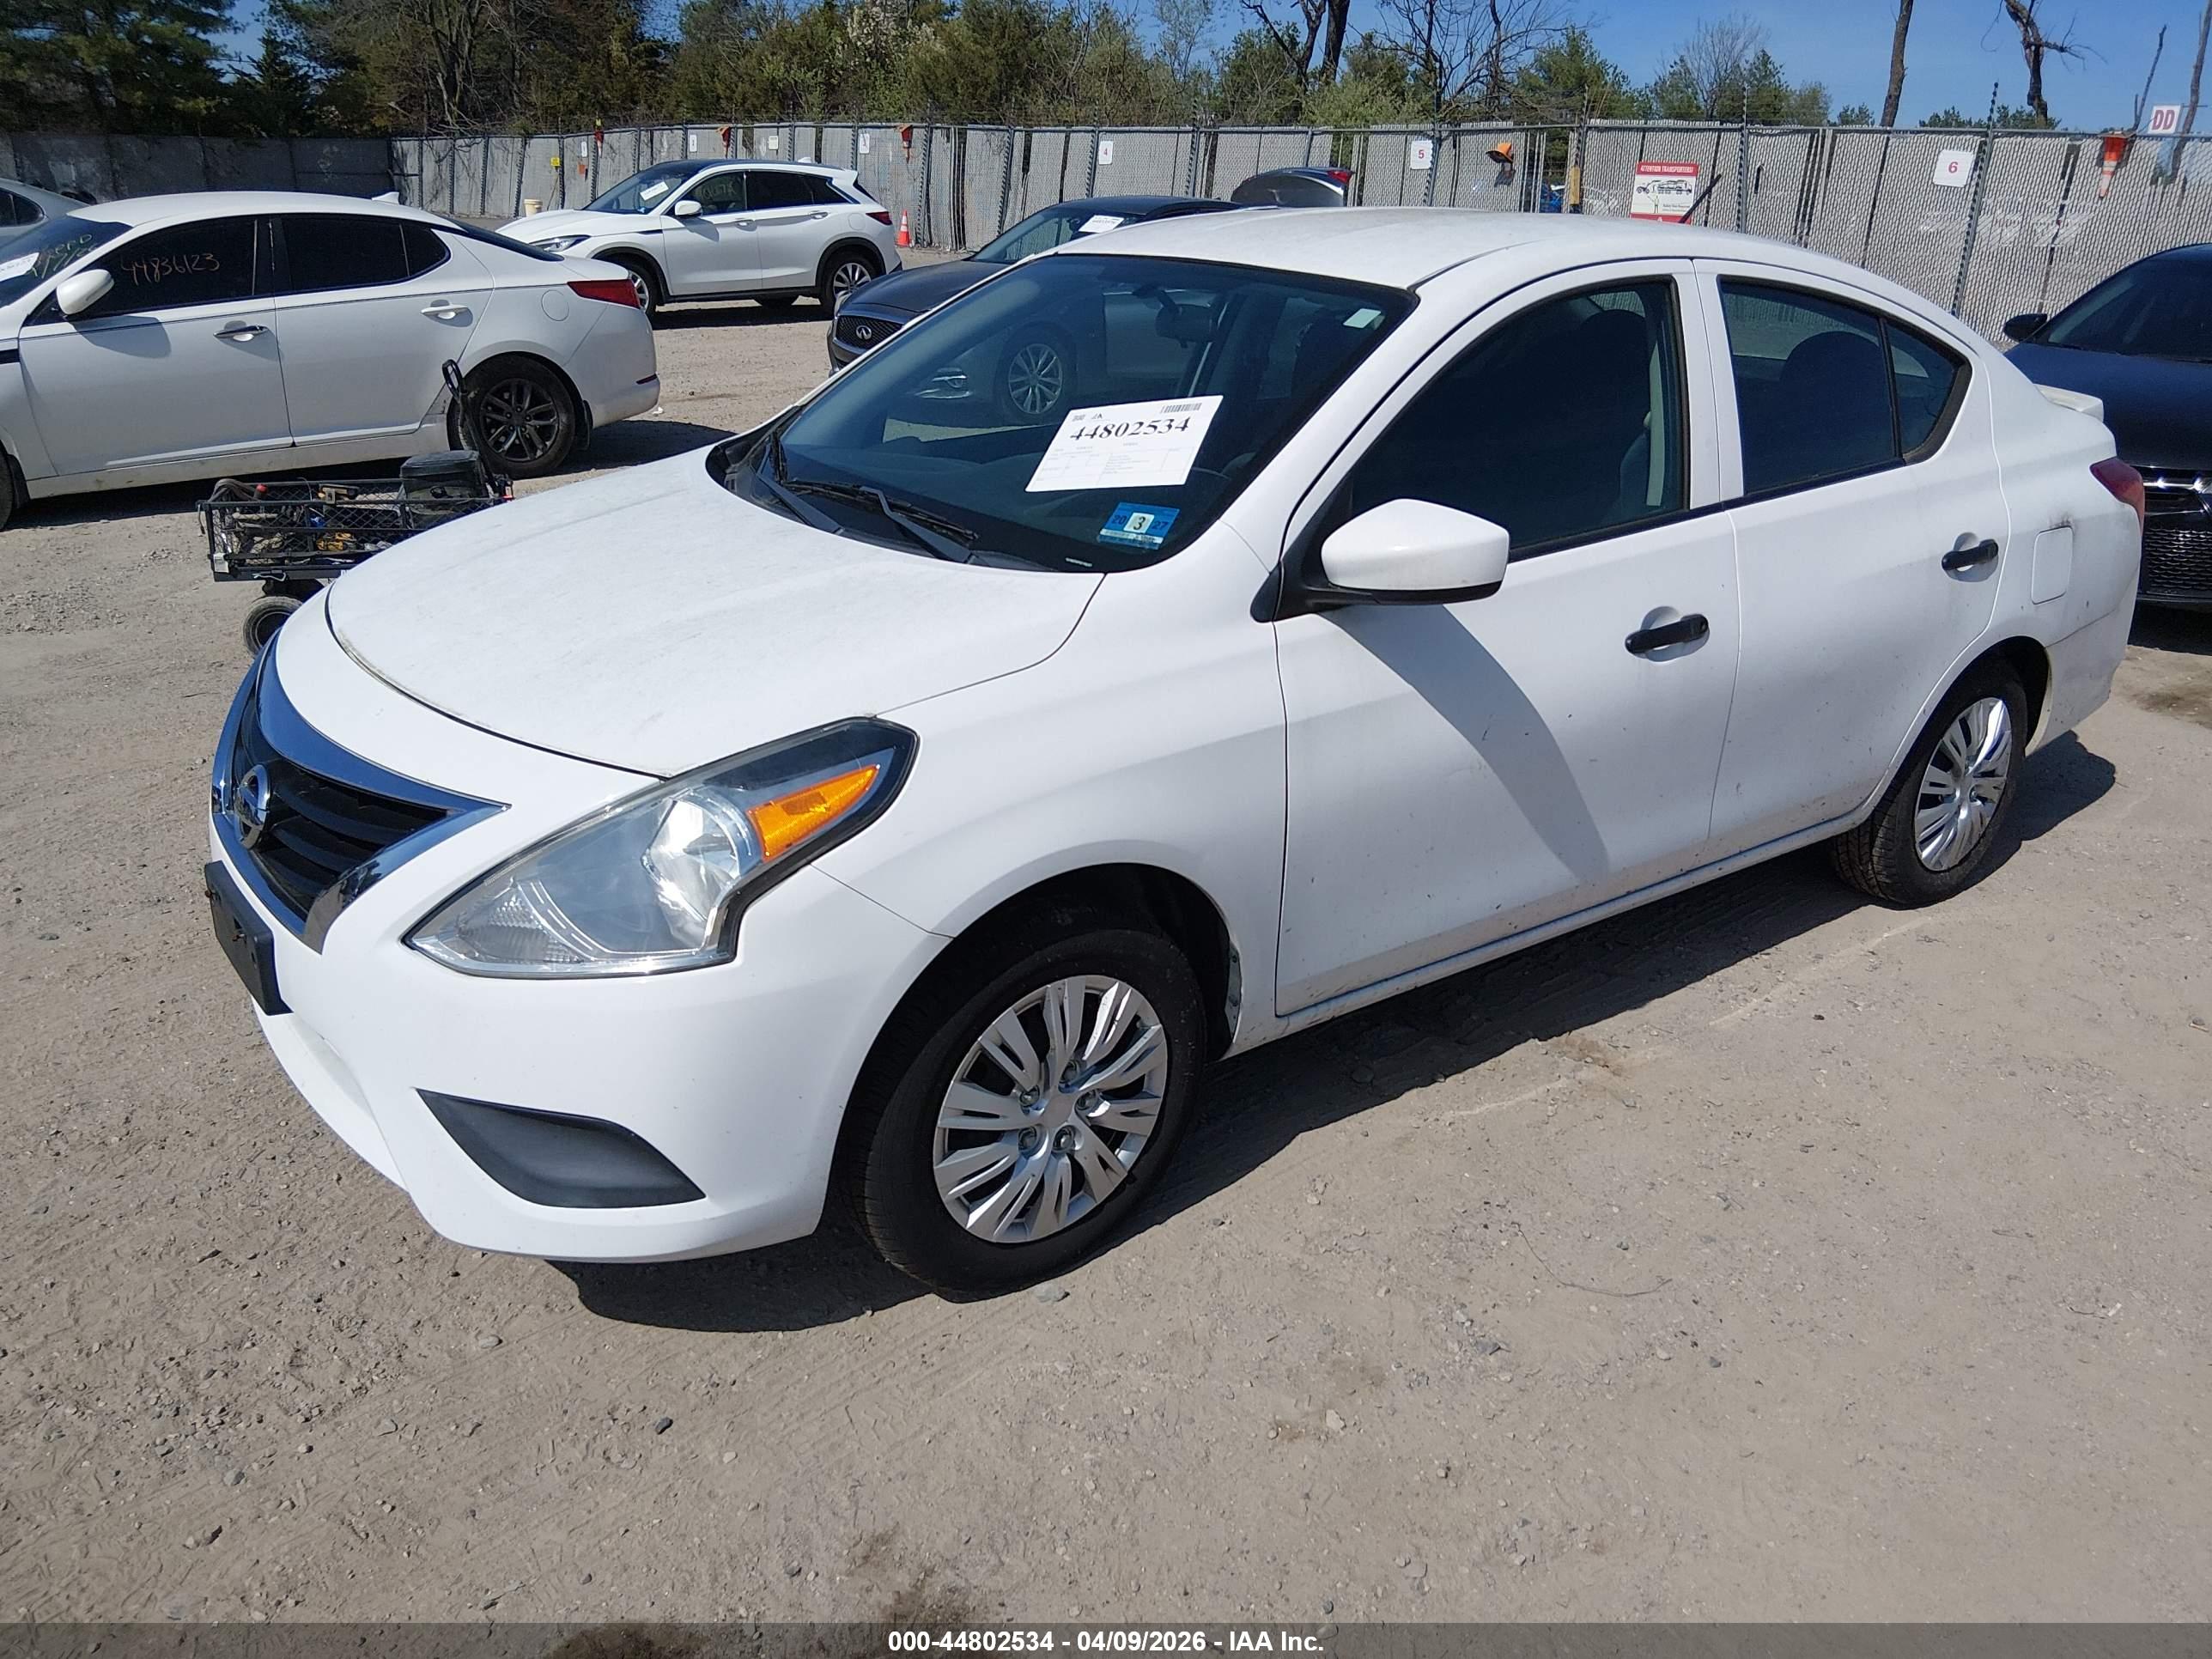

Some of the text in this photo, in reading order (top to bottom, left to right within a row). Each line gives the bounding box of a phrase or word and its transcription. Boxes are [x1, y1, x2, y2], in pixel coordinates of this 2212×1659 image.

[2151, 109, 2175, 131] DD
[1418, 149, 1425, 160] 5
[1948, 161, 1959, 173] 6
[122, 252, 221, 285] 44836123
[1070, 416, 1191, 441] 44802534
[1111, 515, 1127, 526] 20
[1133, 516, 1146, 531] 3
[1152, 520, 1170, 530] 27
